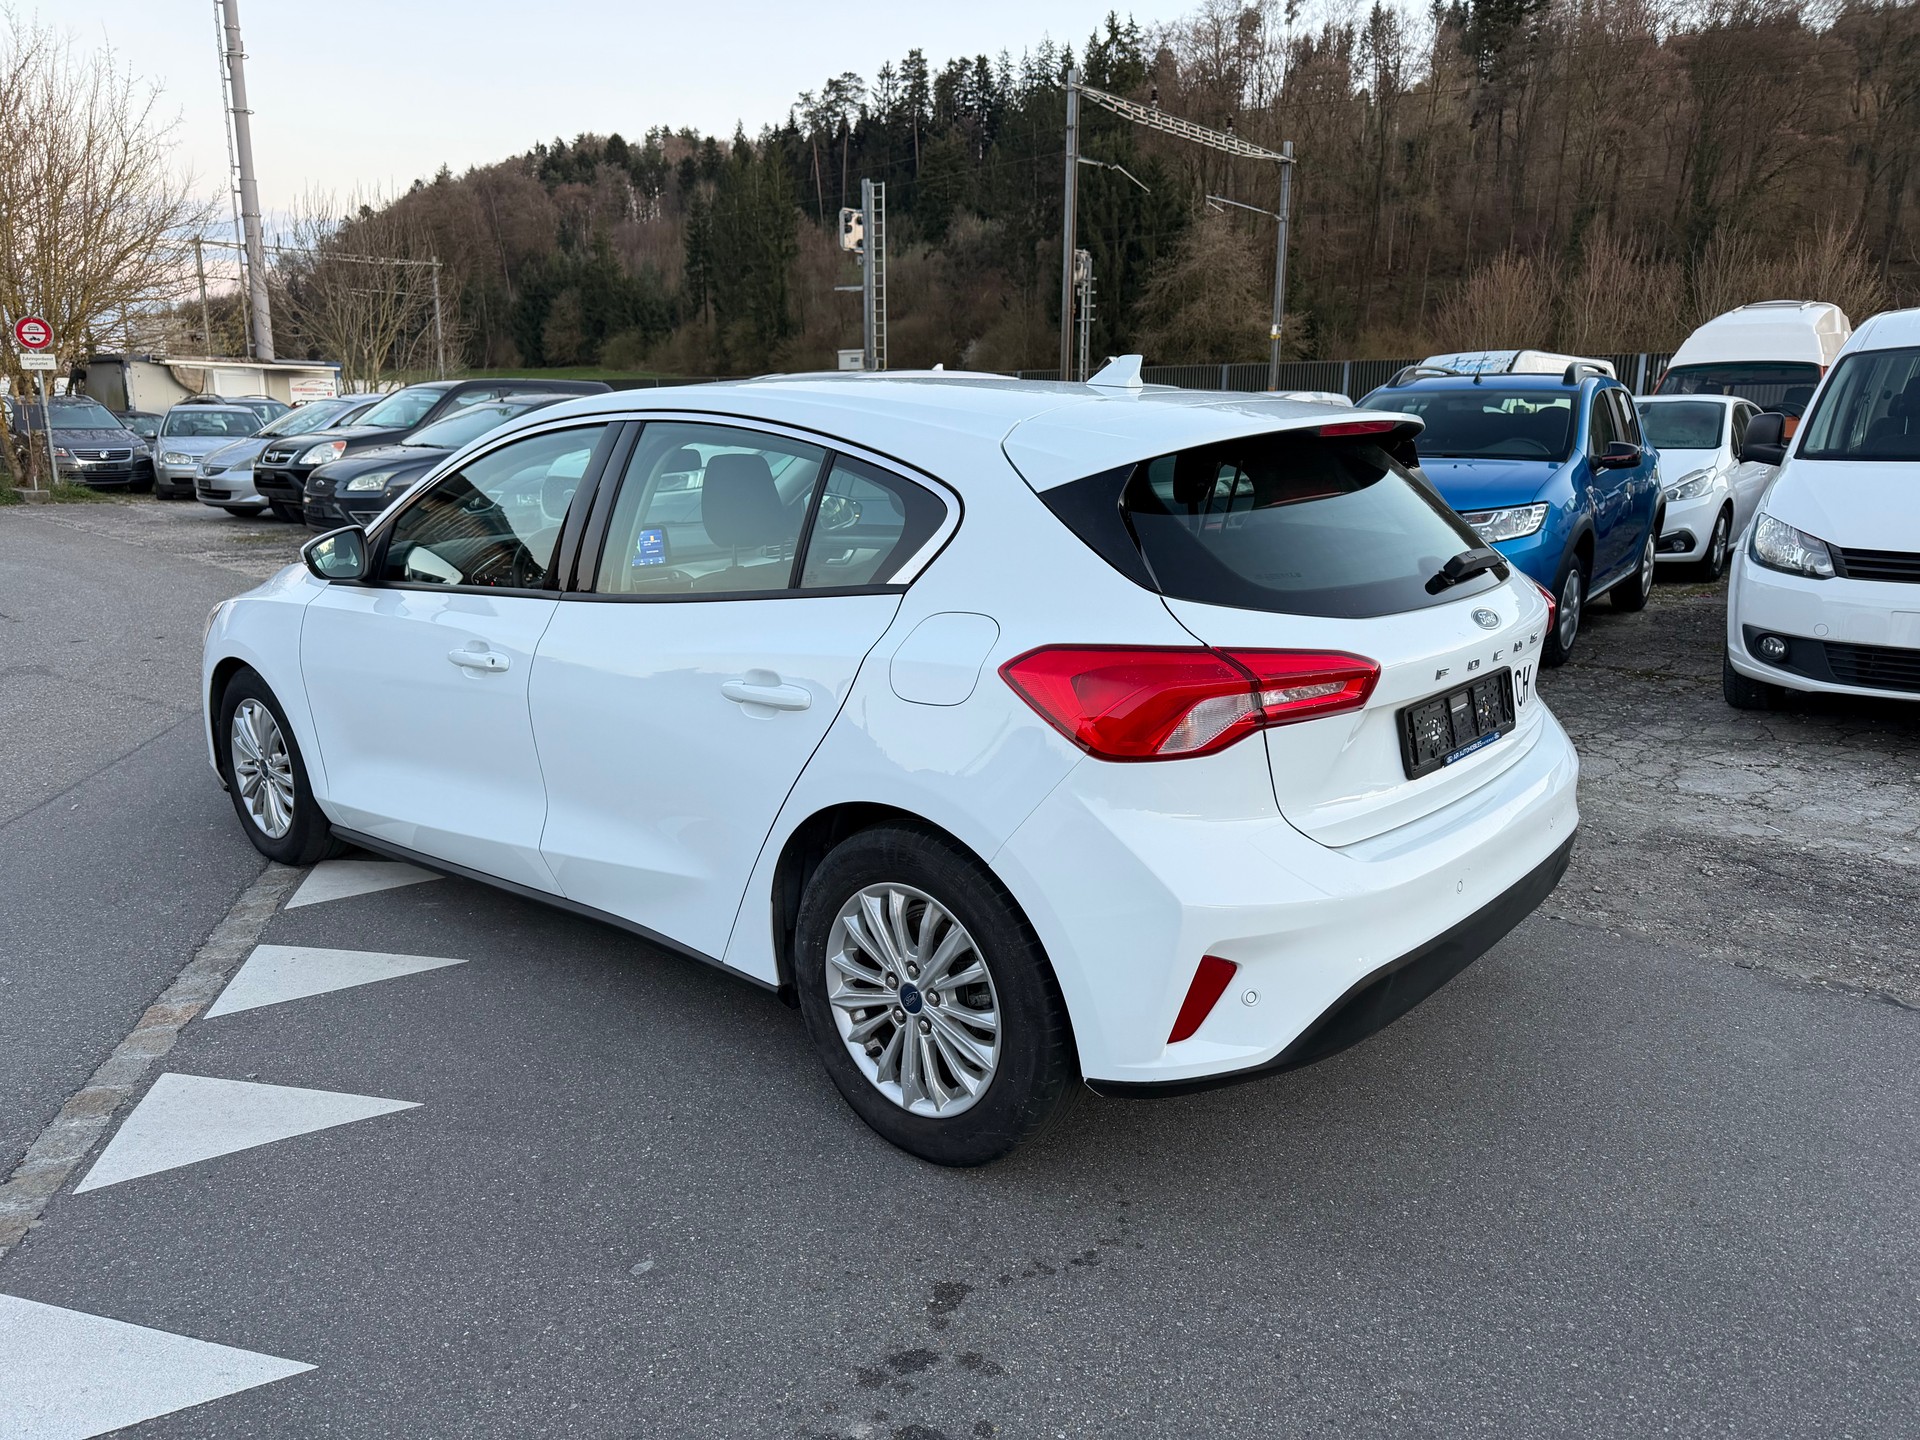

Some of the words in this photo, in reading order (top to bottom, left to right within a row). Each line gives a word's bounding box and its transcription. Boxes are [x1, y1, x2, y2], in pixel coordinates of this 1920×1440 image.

[1477, 611, 1498, 625] Ford
[1434, 632, 1538, 681] FOCUS
[1514, 664, 1532, 707] CH
